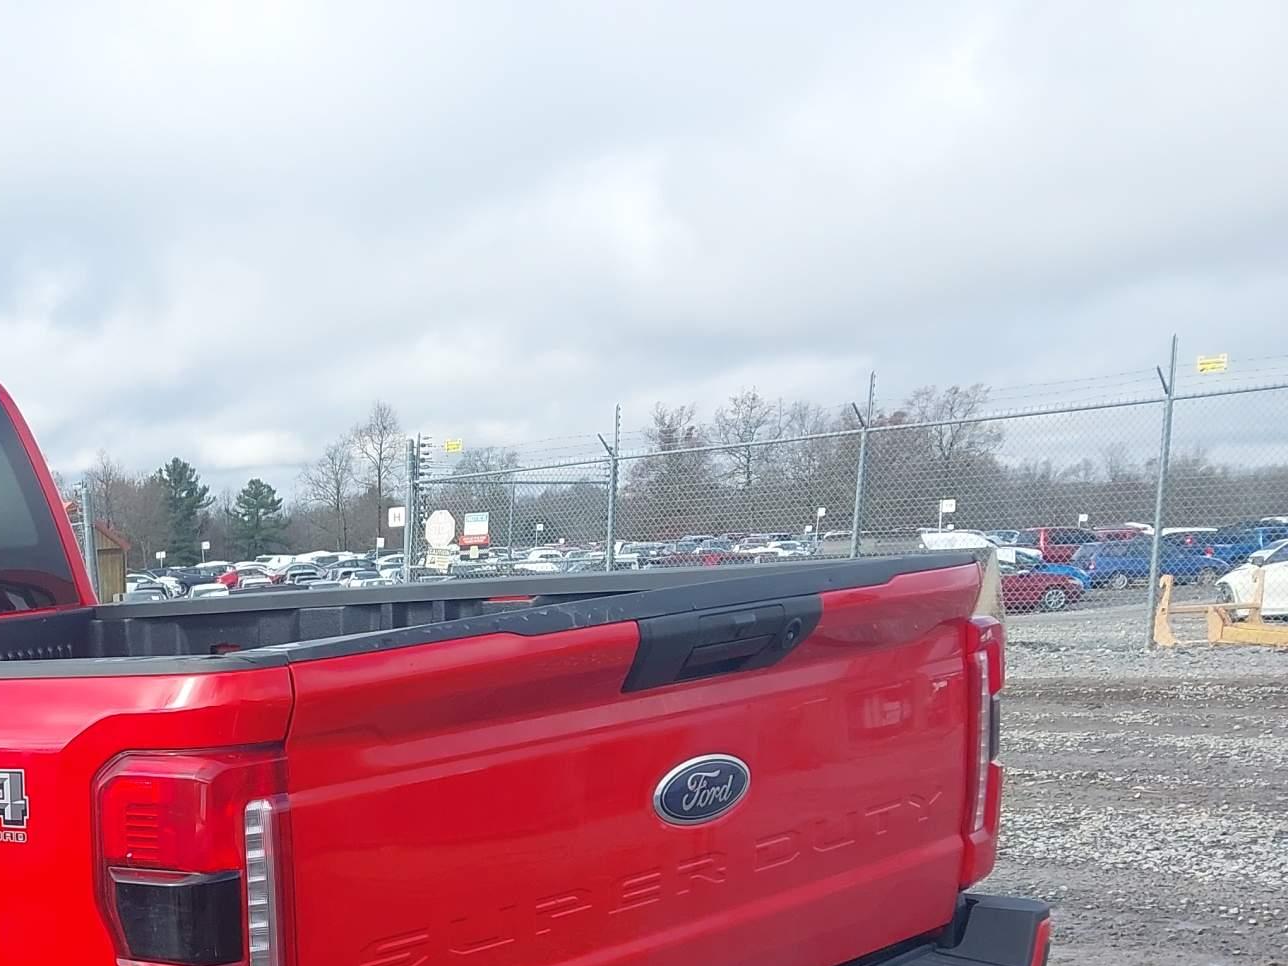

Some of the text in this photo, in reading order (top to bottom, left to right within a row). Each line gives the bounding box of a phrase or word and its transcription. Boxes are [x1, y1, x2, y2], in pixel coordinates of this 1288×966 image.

[393, 511, 401, 523] H
[682, 769, 733, 811] Ford
[754, 791, 943, 873] DUTY
